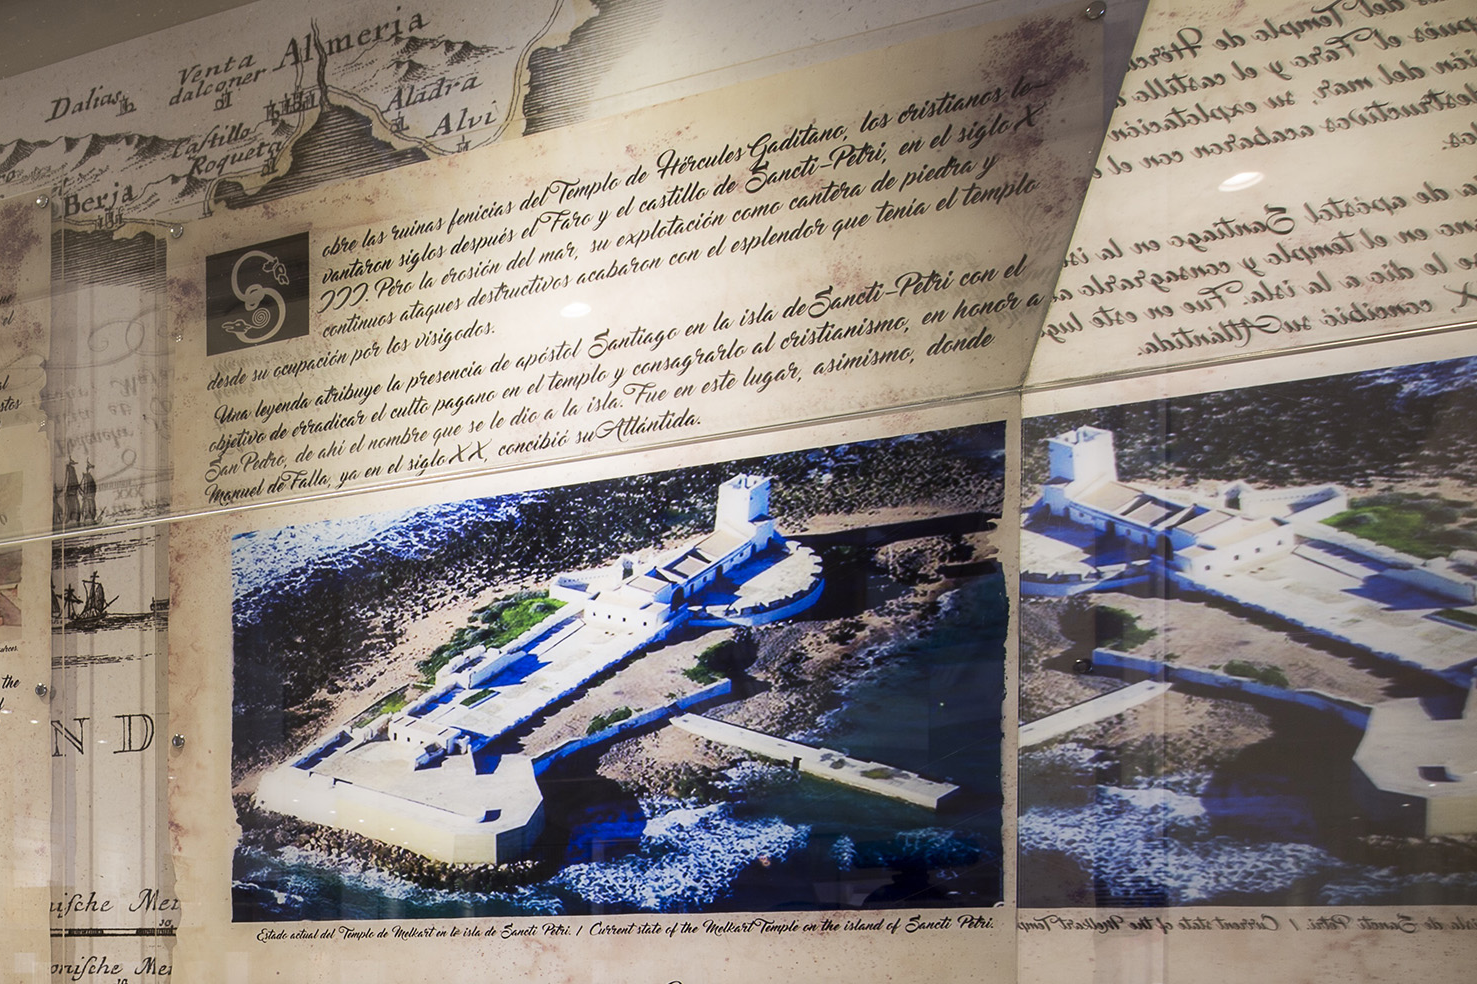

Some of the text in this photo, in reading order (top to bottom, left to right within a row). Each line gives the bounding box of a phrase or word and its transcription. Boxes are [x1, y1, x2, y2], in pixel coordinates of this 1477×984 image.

[178, 54, 256, 85] Venta
[322, 234, 358, 258] obre
[362, 223, 388, 250] las
[393, 220, 444, 240] ruinas
[448, 200, 514, 234] fenicias
[520, 193, 548, 213] del
[550, 178, 620, 209] Templo
[625, 170, 648, 186] de
[656, 147, 745, 179] Hércules
[748, 126, 848, 170] Gaditano,
[860, 111, 892, 134] los
[898, 86, 1005, 125] cristianos
[204, 482, 264, 506] Manuel
[268, 480, 283, 495] de
[280, 470, 332, 490] Falla,
[339, 471, 359, 489] ya
[365, 467, 382, 479] en
[387, 459, 404, 475] el
[407, 453, 445, 477] siglo
[498, 431, 567, 457] concibió
[576, 431, 595, 445] su
[594, 412, 702, 445] Atlántida.
[256, 928, 287, 943] Estado
[290, 929, 318, 939] actual
[320, 928, 335, 939] del
[338, 926, 374, 939] Templo
[377, 929, 389, 938] de
[391, 926, 434, 940] Melkart
[436, 929, 447, 938] en
[463, 928, 482, 937] isla
[485, 926, 496, 936] de
[501, 923, 537, 939] Sancti
[543, 924, 571, 936] Petri.
[589, 922, 634, 936] Current
[637, 923, 663, 934] state
[665, 924, 678, 938] of
[681, 922, 698, 933] the
[702, 919, 755, 937] Melkart
[754, 919, 800, 934] Temple
[803, 923, 818, 932] on
[821, 920, 840, 932] the
[844, 919, 883, 932] island
[886, 919, 901, 934] of
[906, 915, 952, 933] Sancti
[957, 915, 994, 930] Petri.
